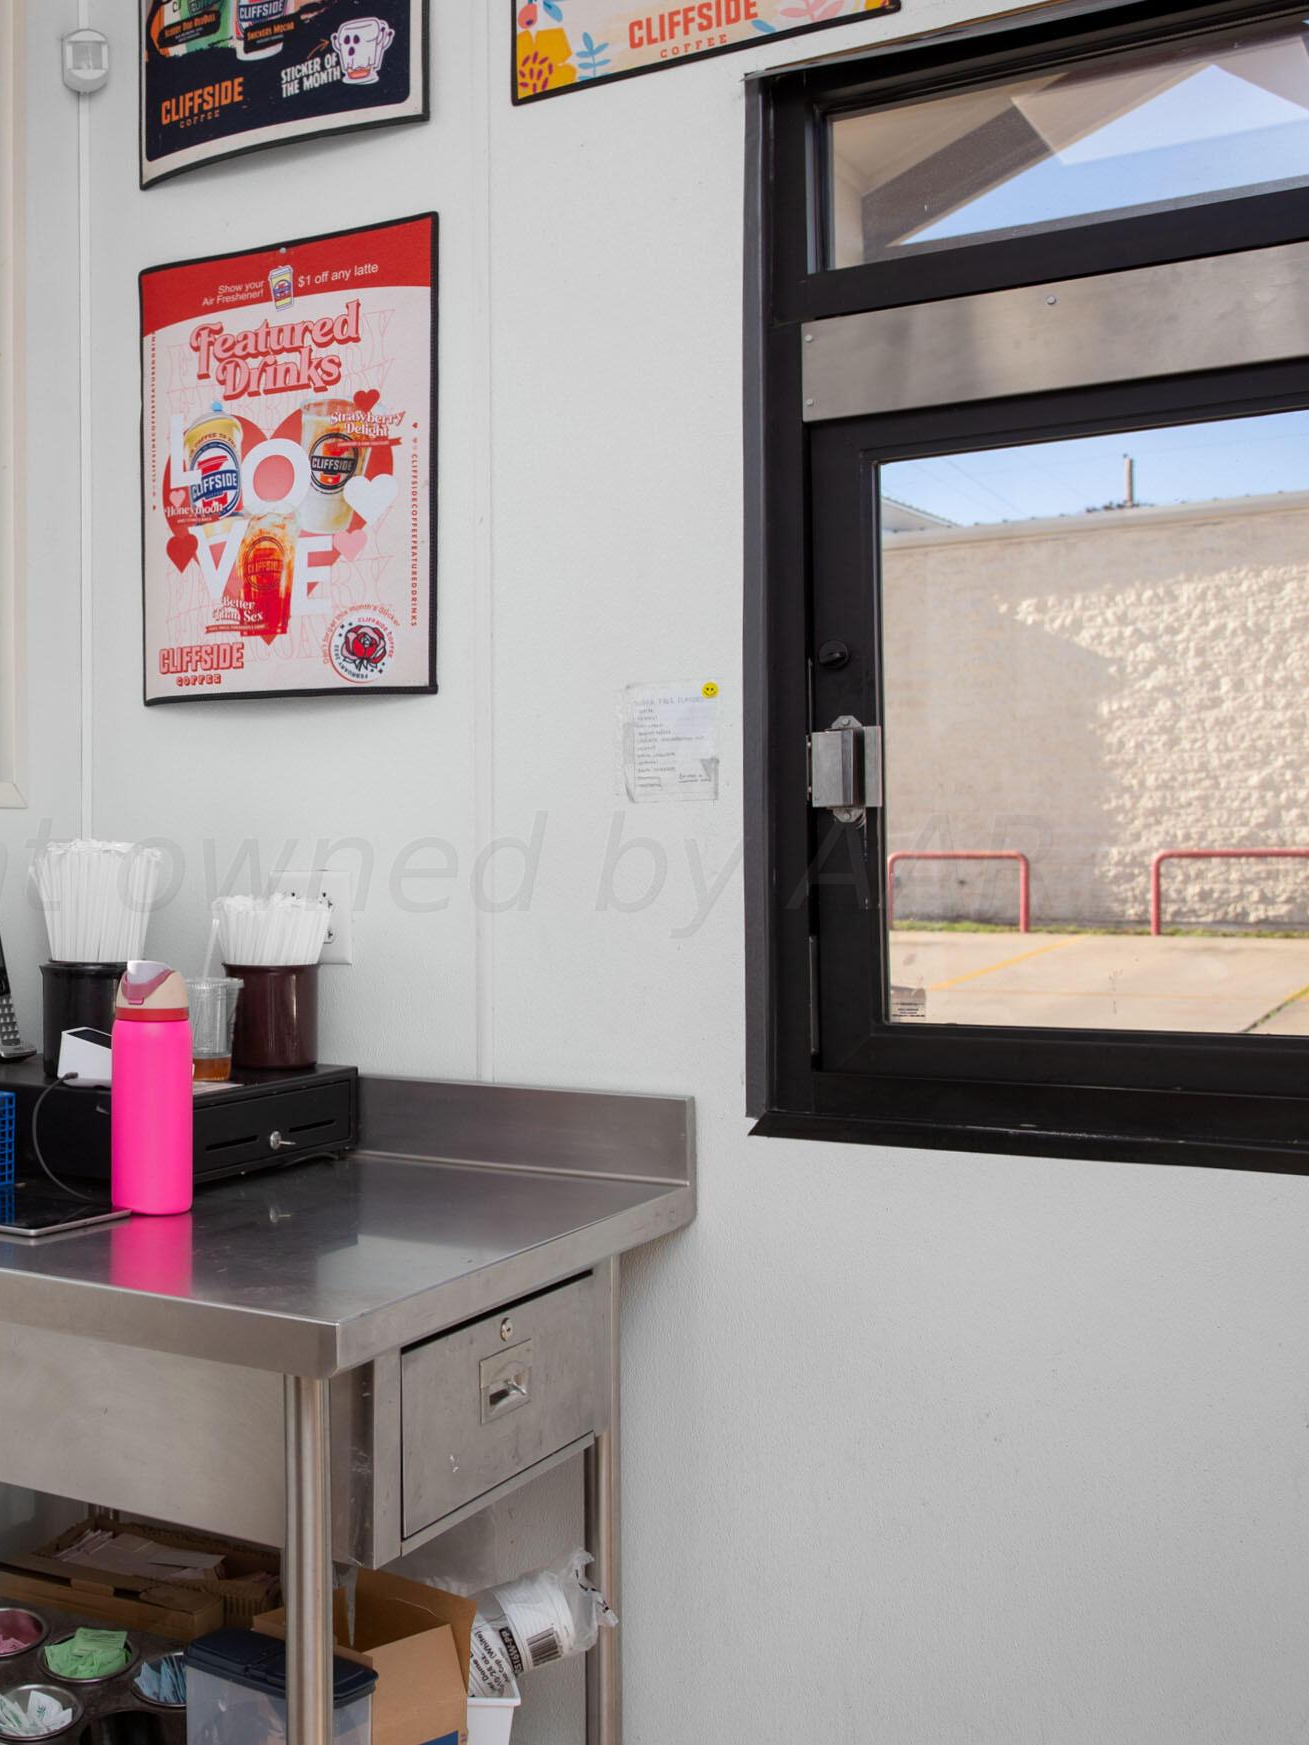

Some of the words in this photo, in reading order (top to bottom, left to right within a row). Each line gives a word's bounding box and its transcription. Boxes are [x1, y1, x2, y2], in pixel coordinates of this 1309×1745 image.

[239, 2, 283, 18] CLIFFSIDE
[628, 0, 758, 49] CLIFFSIDE
[659, 34, 728, 58] COFFEE
[281, 60, 321, 84] STICKER
[324, 53, 338, 69] OF
[281, 81, 300, 99] THE
[303, 65, 341, 91] MONTH
[161, 77, 244, 126] CLIFFSIDE
[179, 109, 220, 128] COFFEE
[298, 276, 311, 288] $1
[314, 272, 328, 284] off
[331, 269, 351, 282] any
[354, 263, 379, 276] latte
[201, 297, 214, 307] Air
[216, 290, 264, 305] Freshener!
[218, 284, 243, 295] Show
[244, 281, 265, 293] your
[190, 298, 361, 380] Featured
[216, 345, 342, 401] Drinks
[329, 410, 406, 428] Strawberry
[345, 423, 390, 439] Delight
[311, 457, 354, 472] CLIFFSIDE
[158, 642, 245, 674] CLIFFSIDE
[176, 673, 222, 687] COFFEE
